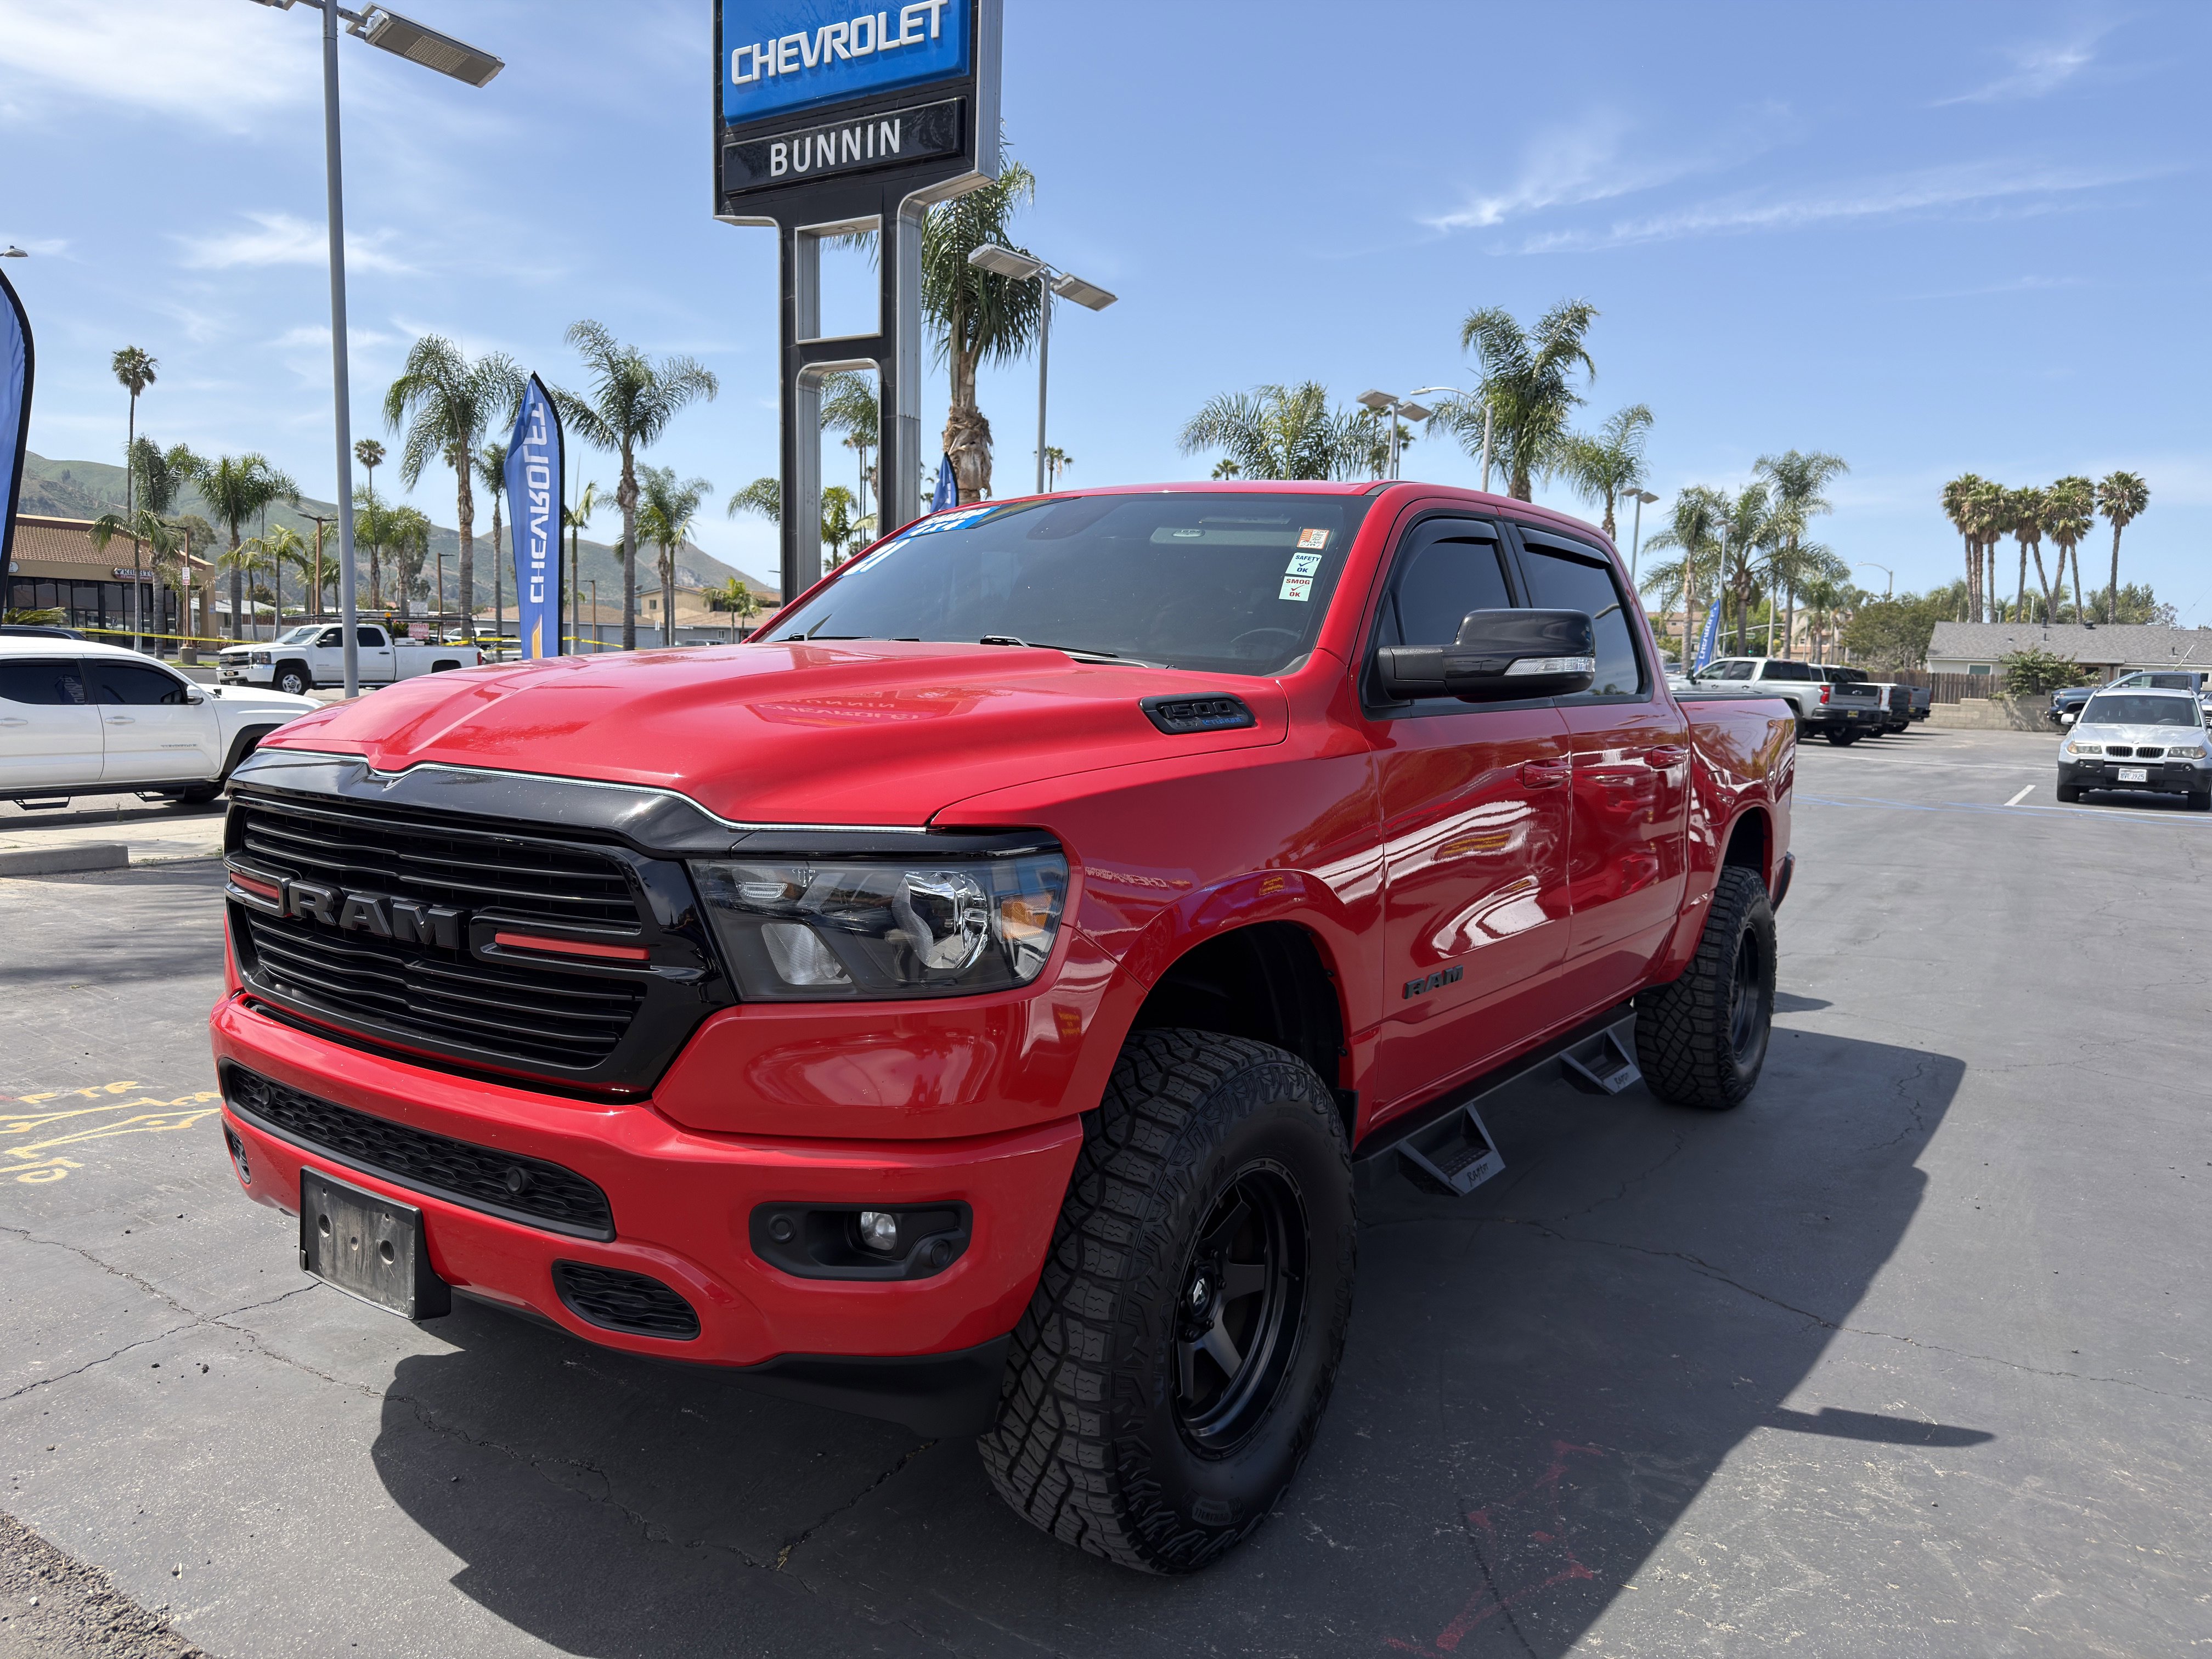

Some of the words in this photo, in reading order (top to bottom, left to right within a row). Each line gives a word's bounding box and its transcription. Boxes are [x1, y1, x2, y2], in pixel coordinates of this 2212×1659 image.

[732, 0, 948, 85] CHEVROLET
[771, 119, 901, 177] BUNNIN
[1159, 701, 1234, 718] 1500
[288, 879, 464, 950] RAM
[1403, 964, 1464, 1000] RAM
